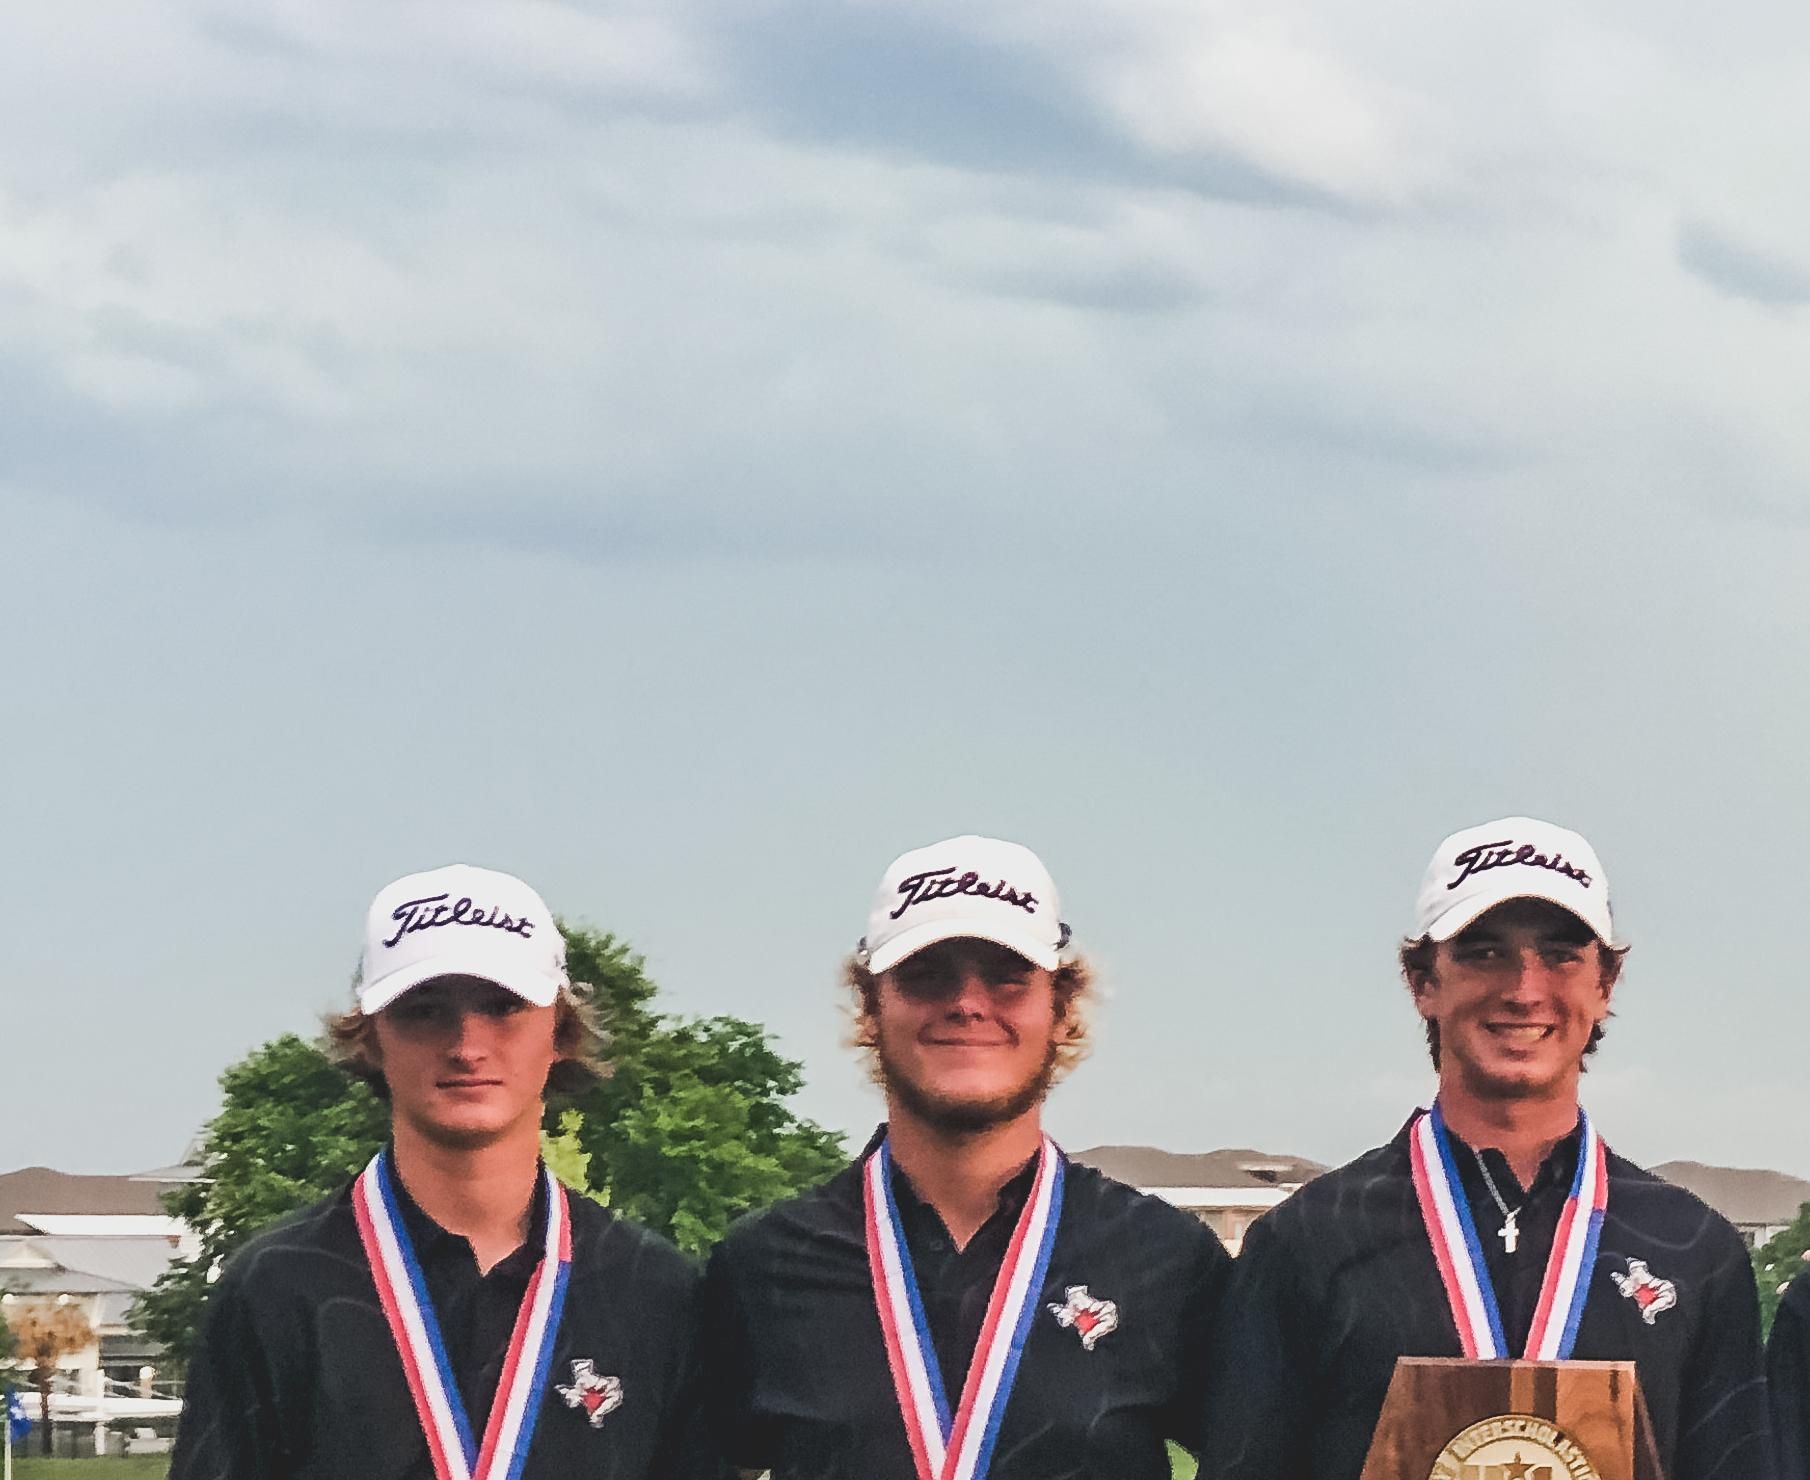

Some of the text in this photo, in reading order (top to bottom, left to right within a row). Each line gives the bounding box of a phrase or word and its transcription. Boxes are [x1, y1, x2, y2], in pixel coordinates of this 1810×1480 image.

[1447, 840, 1592, 889] Titleist
[890, 866, 1039, 920] Titleist
[382, 893, 535, 948] Titleist
